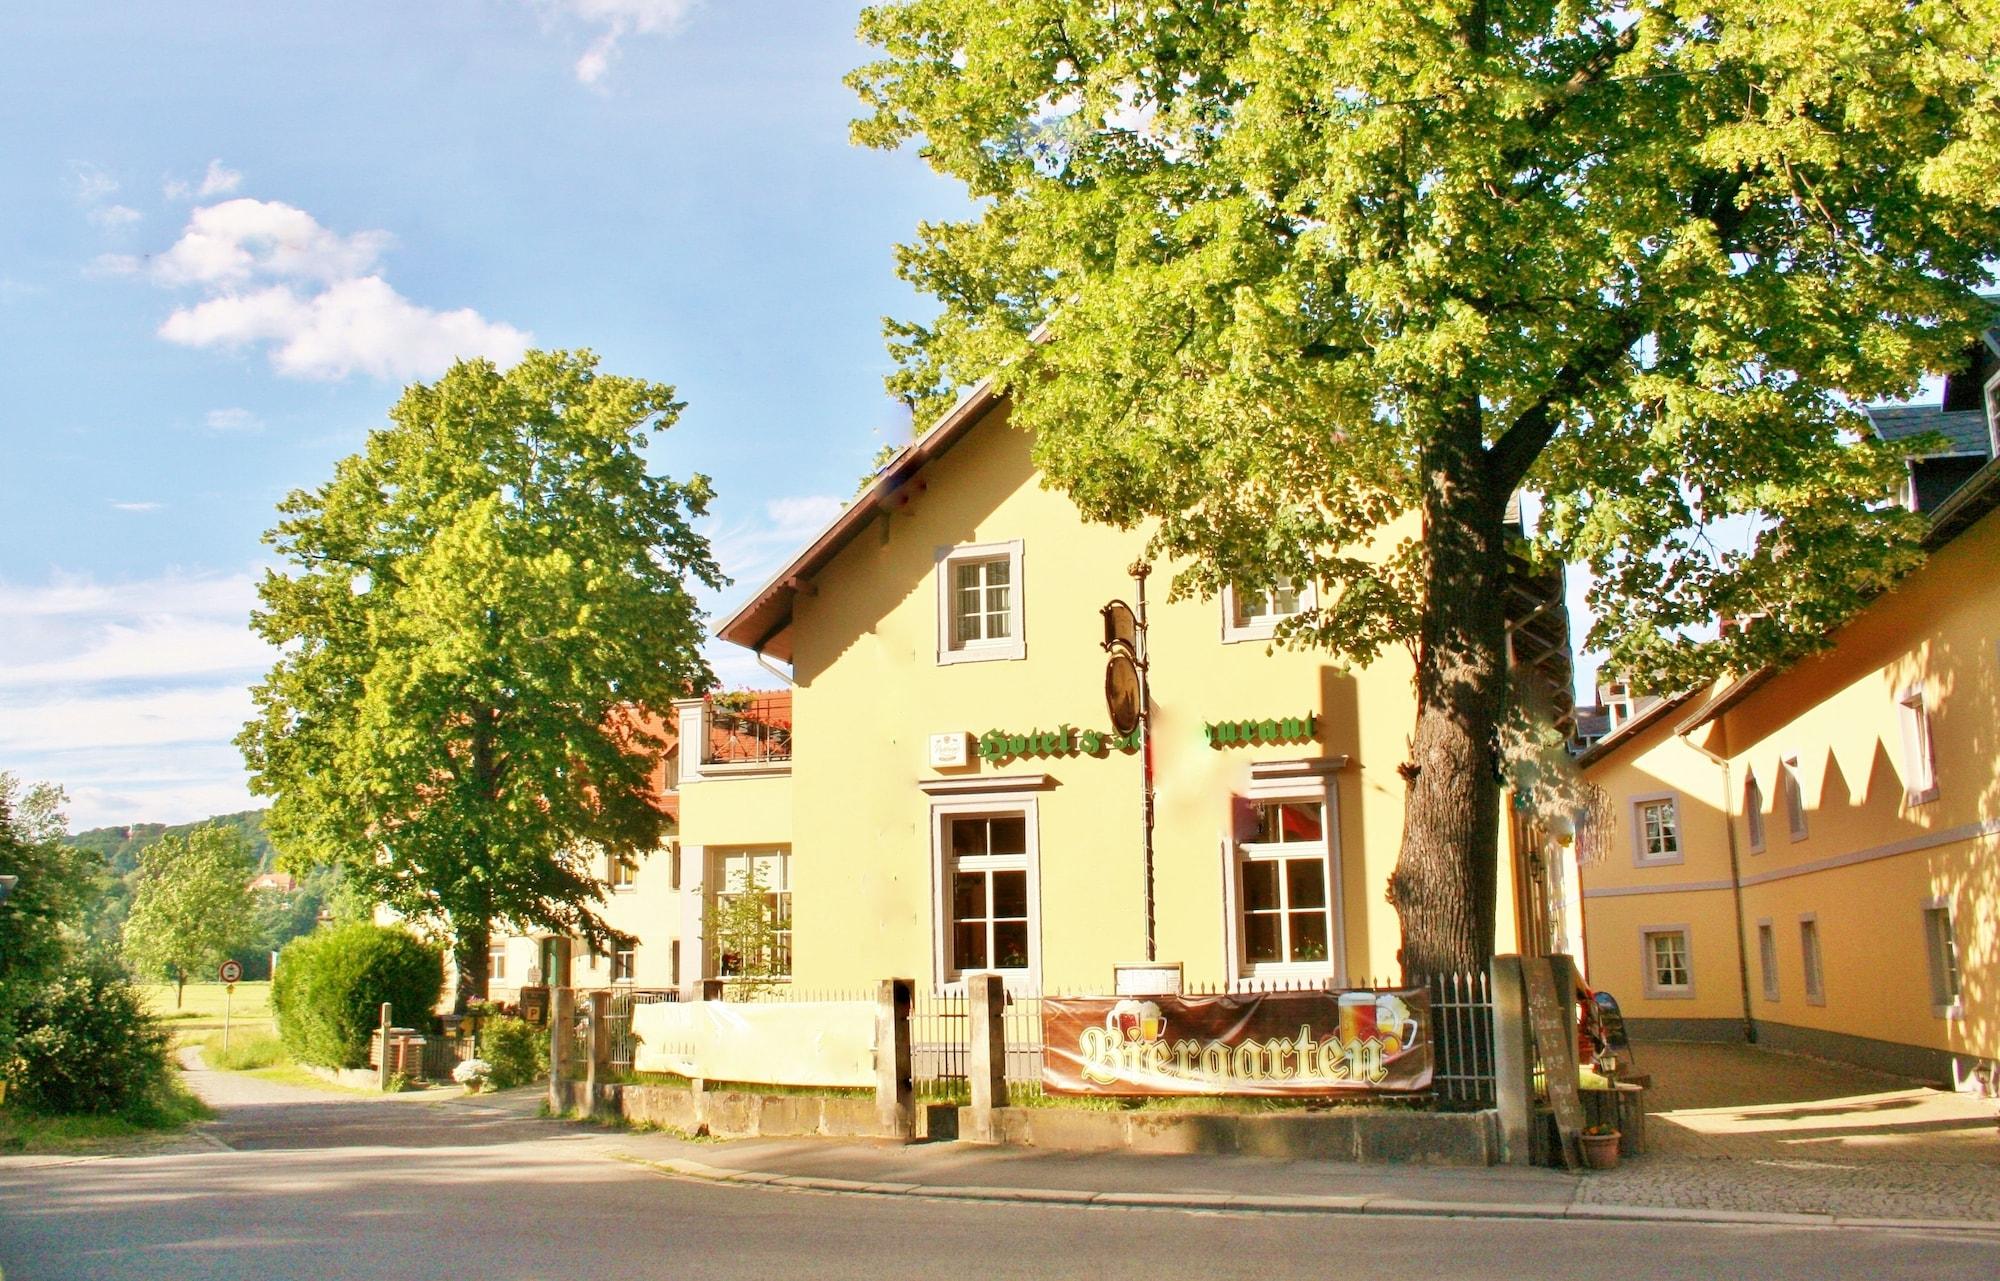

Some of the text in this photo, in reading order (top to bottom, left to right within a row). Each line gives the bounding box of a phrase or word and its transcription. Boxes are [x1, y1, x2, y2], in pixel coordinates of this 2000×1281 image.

[978, 723, 1071, 764] Hotel
[1080, 729, 1104, 753] &
[1079, 1024, 1389, 1095] Biergarten
